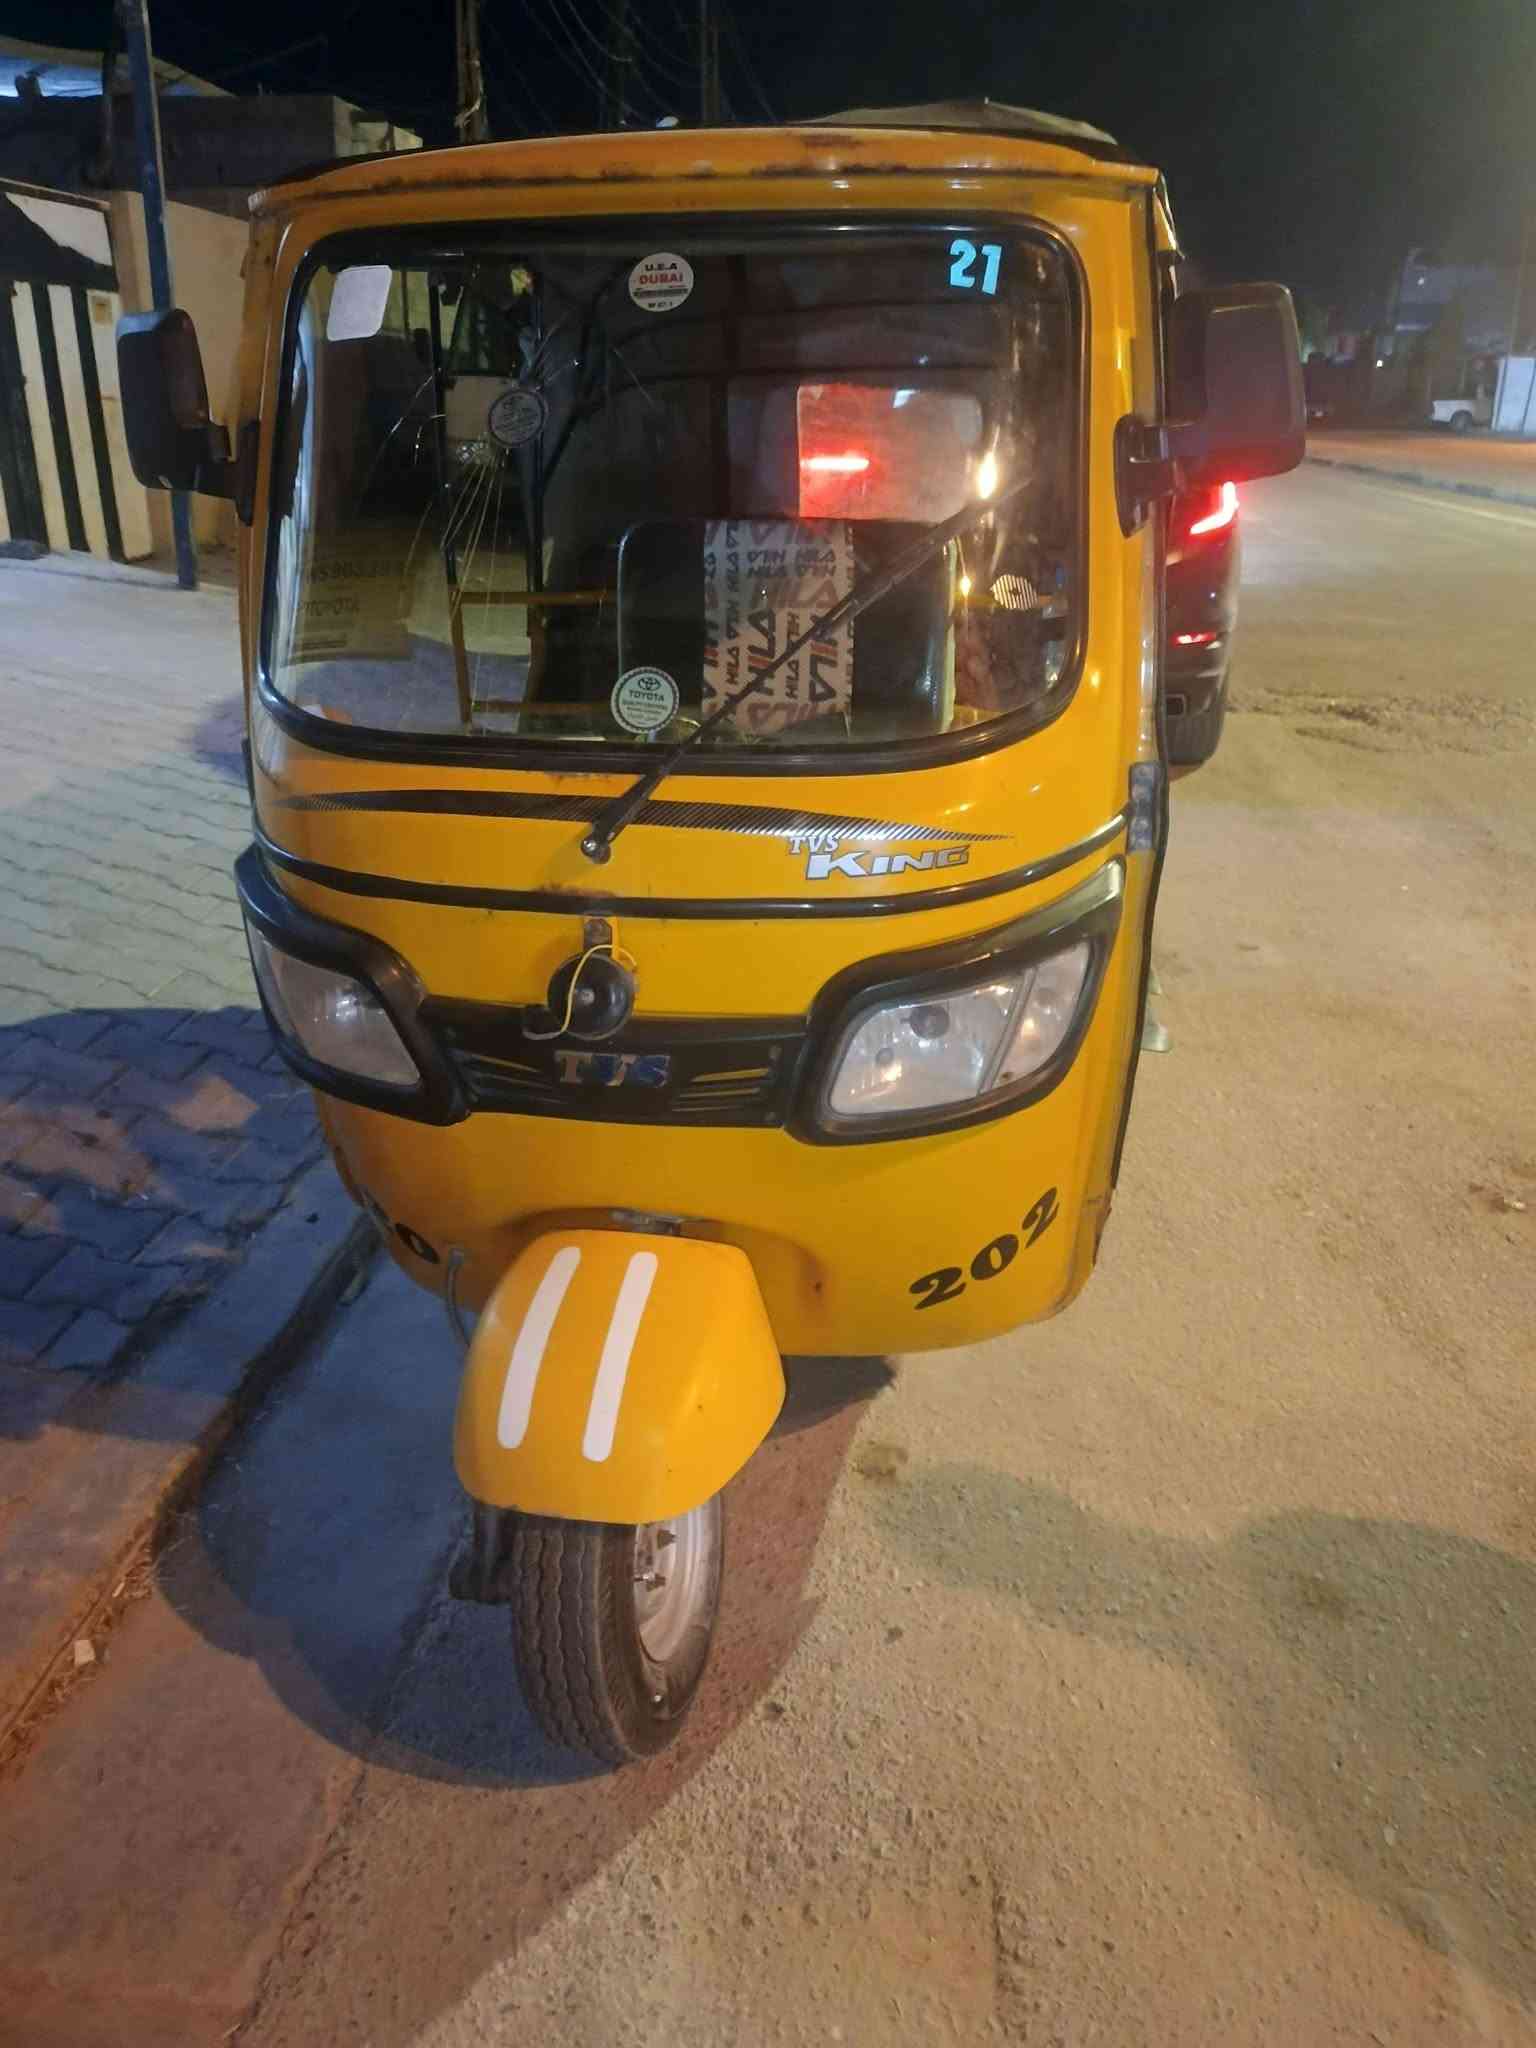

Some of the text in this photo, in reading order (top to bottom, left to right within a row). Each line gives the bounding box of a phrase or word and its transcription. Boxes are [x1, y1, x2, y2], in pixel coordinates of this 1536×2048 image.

[639, 273, 684, 286] DUBAI
[628, 689, 665, 702] TOYOTA
[788, 836, 840, 855] TVS
[806, 845, 971, 880] KING
[908, 1186, 1060, 1311] 202
